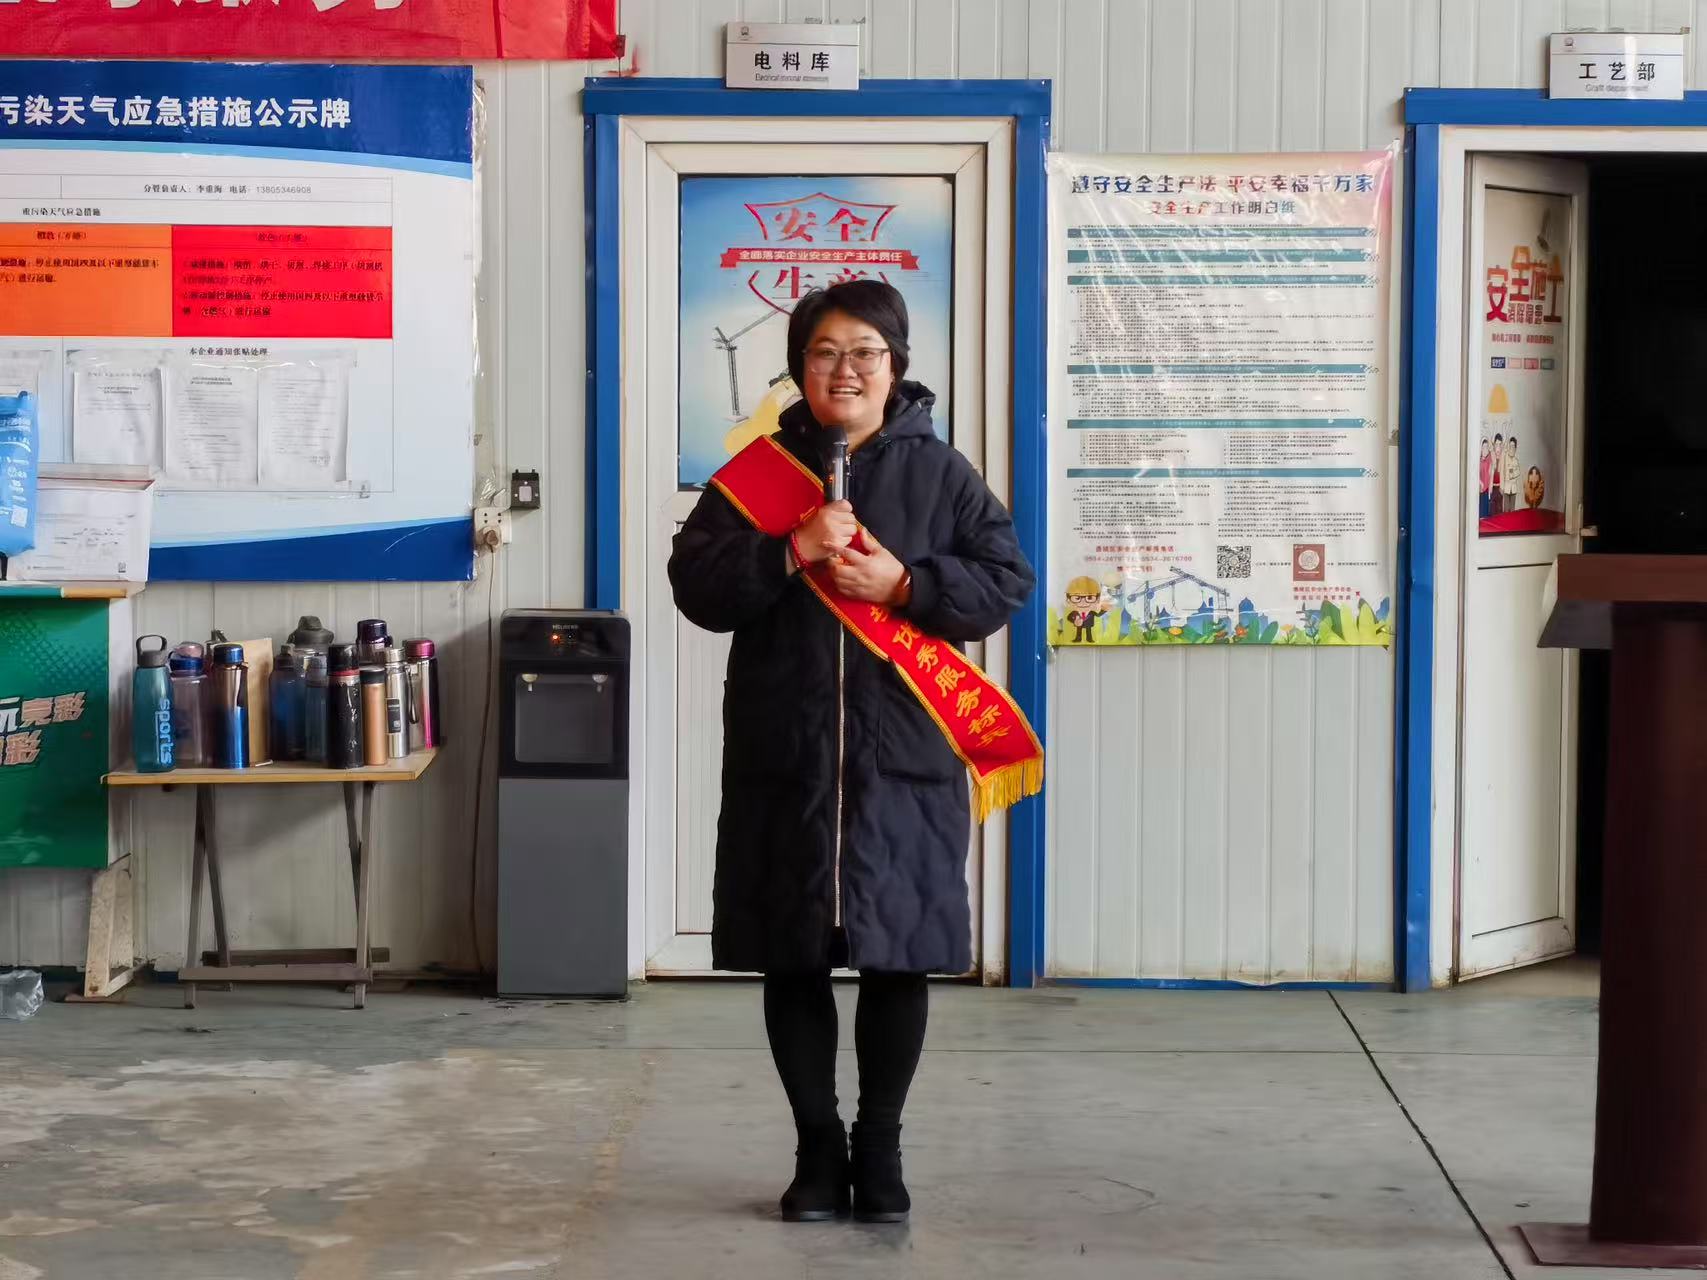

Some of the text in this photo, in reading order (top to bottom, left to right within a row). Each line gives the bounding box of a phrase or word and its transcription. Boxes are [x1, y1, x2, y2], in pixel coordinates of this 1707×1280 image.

[754, 51, 830, 71] 电料库
[1578, 61, 1656, 81] 工艺部
[0, 95, 351, 129] 污染天气应急措施公示牌
[1071, 174, 1375, 194] 遵守安全生产法 平安幸福千万家
[1151, 200, 1296, 215] 安全生产工作明白纸
[774, 207, 869, 243] 安全
[739, 250, 903, 263] 全面落实企业安全生产主体责任
[155, 697, 174, 765] sports
